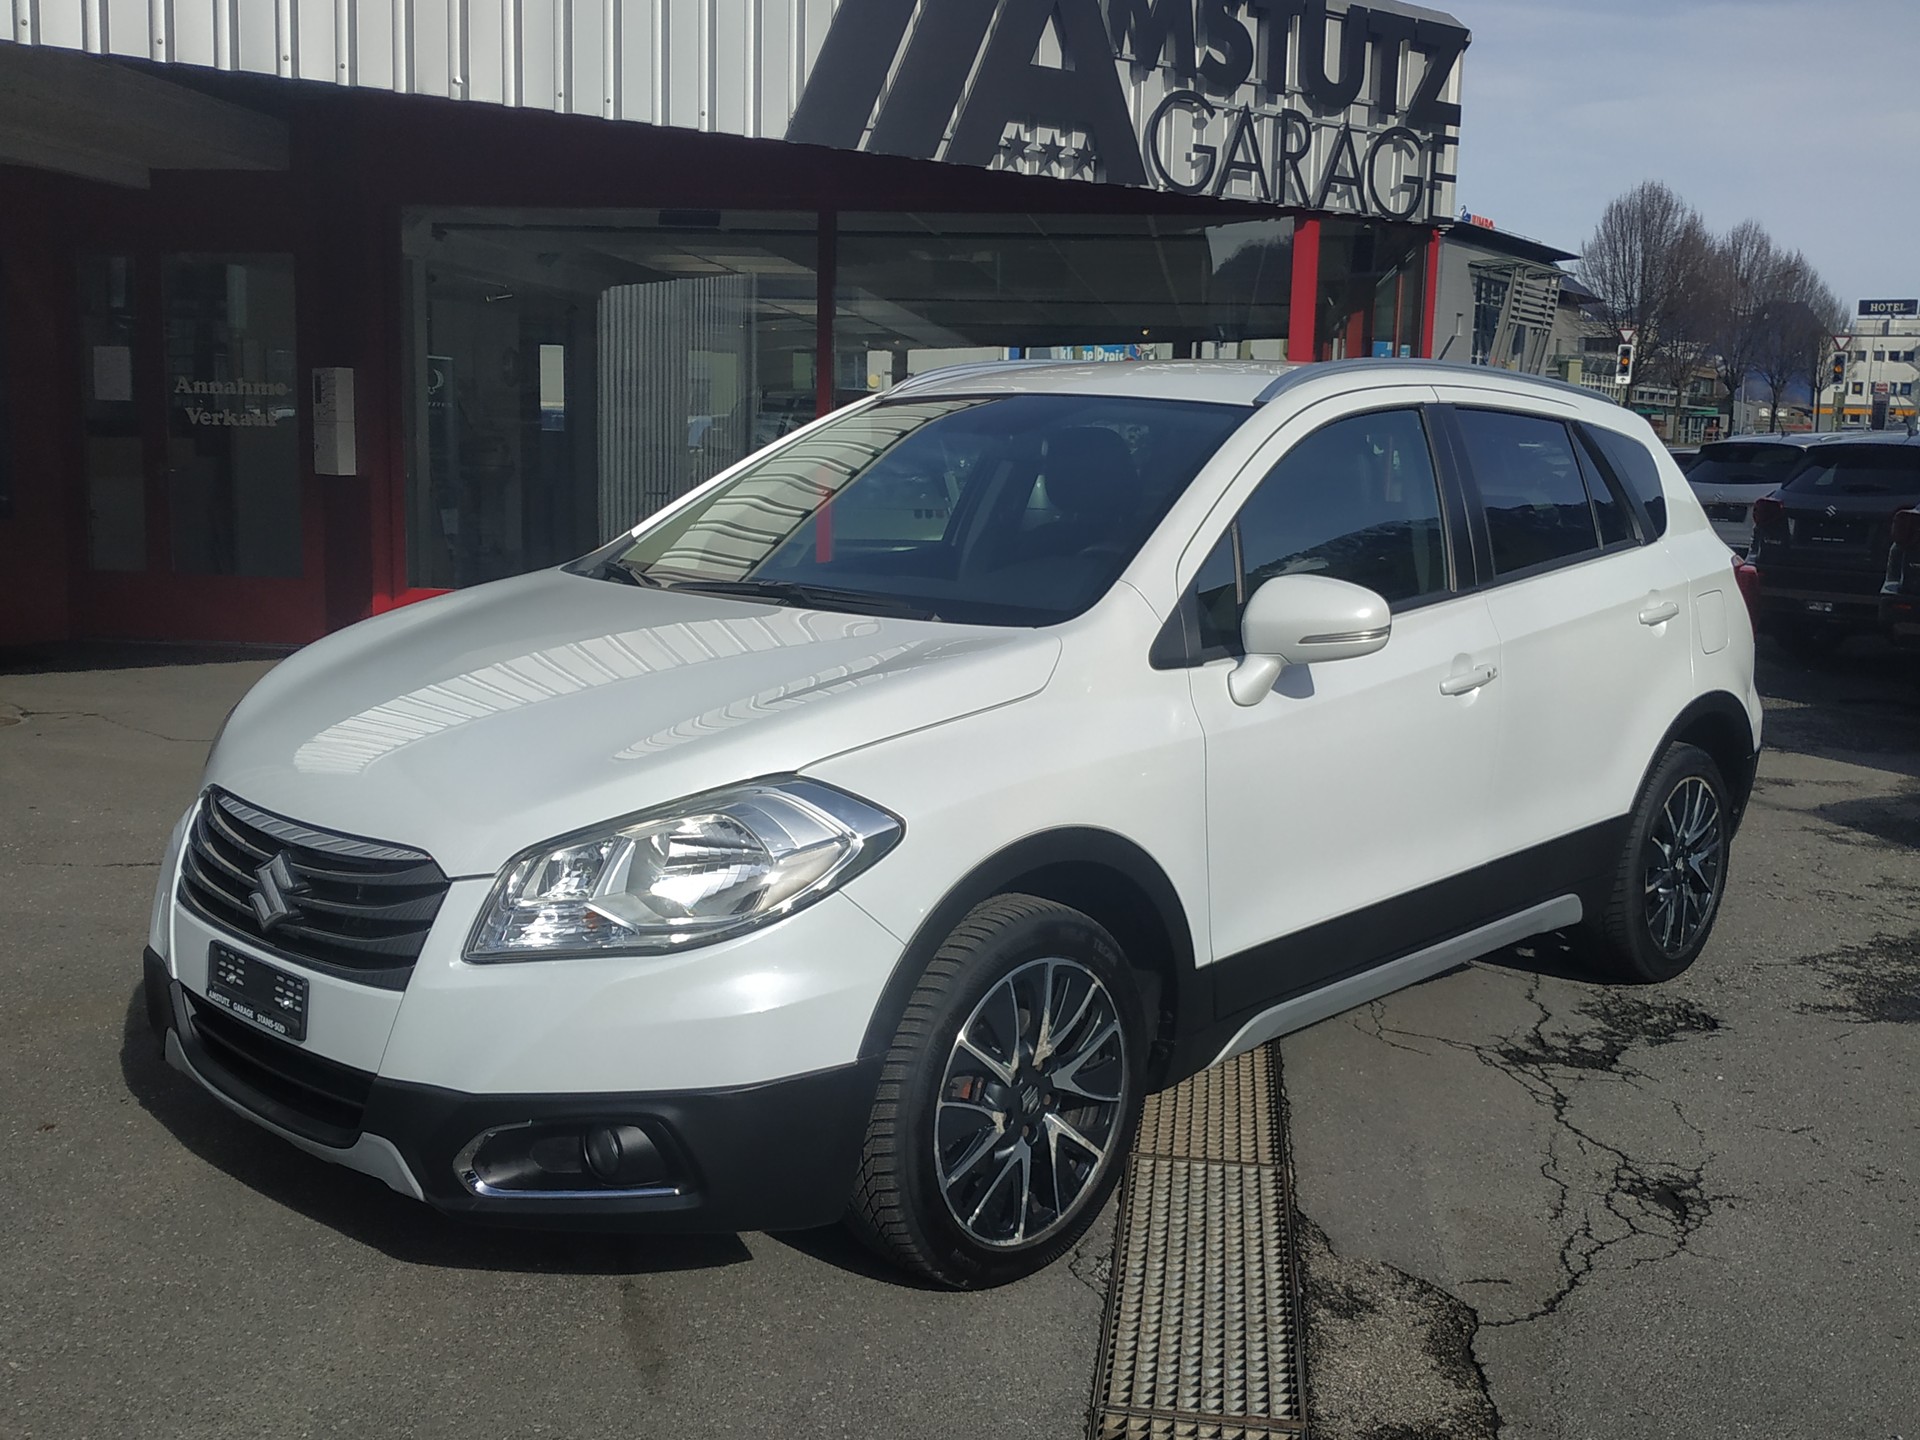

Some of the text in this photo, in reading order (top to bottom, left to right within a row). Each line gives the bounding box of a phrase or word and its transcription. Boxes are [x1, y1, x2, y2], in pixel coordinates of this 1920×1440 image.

[942, 0, 1472, 187] AMSTUTZ
[1150, 89, 1460, 226] GARAGE
[1870, 302, 1905, 312] HOTEL
[174, 376, 293, 396] Annahme-
[185, 406, 279, 428] Verkauf
[208, 990, 231, 1007] AMSTUTZ
[232, 1002, 255, 1019] GARAGE
